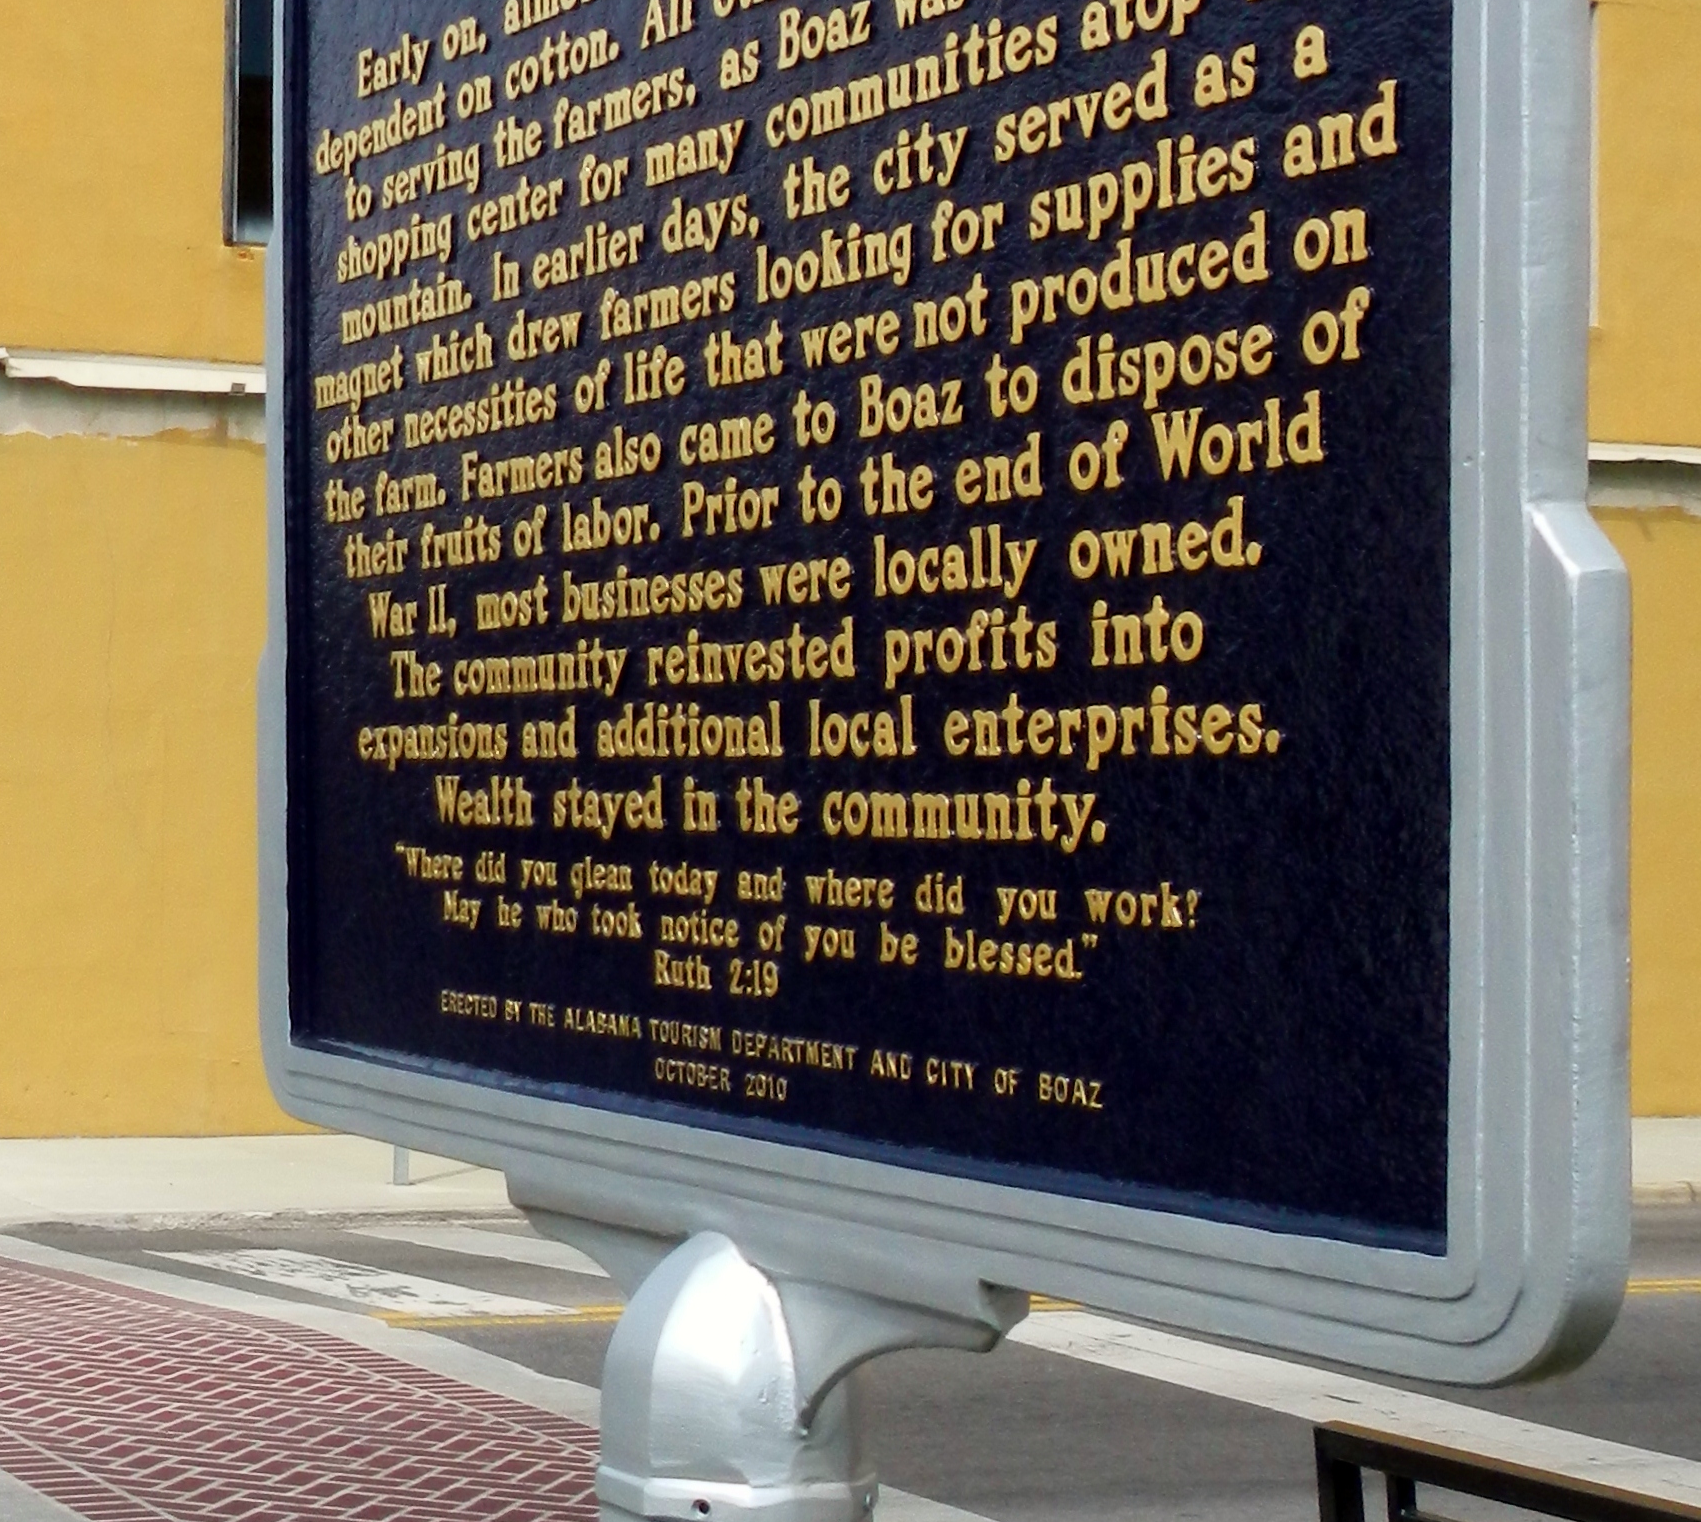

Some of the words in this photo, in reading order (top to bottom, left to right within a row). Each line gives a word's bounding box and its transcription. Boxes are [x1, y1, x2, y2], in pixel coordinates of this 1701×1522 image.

[314, 85, 447, 180] dependent
[456, 77, 493, 119] on
[504, 29, 620, 100] cotton.
[345, 181, 373, 222] to
[382, 144, 481, 209] serving
[493, 117, 543, 169] the
[553, 67, 697, 149] farmers,
[719, 39, 760, 91] as
[778, 0, 872, 70] Boaz
[358, 34, 430, 96] Early
[441, 18, 487, 61] on,
[337, 214, 453, 284] shopping
[466, 176, 564, 242] center
[578, 154, 630, 208] for
[645, 117, 745, 188] many
[765, 14, 1058, 149] communities
[341, 274, 473, 345] mountain.
[491, 251, 521, 302] In
[532, 220, 645, 291] earlier
[660, 192, 760, 255] days,
[782, 155, 851, 221] the
[872, 121, 969, 196] city
[993, 47, 1169, 164] served
[1193, 43, 1257, 109] as
[1292, 23, 1329, 80] a
[314, 347, 405, 415] magnet
[415, 321, 494, 383] which
[505, 309, 582, 362] drew
[599, 271, 736, 342] farmers
[755, 222, 914, 305] looking
[930, 198, 1005, 264] for
[1028, 133, 1256, 242] supplies
[1282, 78, 1399, 179] and
[325, 412, 395, 465] other
[403, 376, 558, 449] necessities
[573, 358, 612, 415] of
[623, 344, 687, 406] life
[702, 319, 785, 389] that
[800, 309, 902, 369] were
[912, 272, 990, 349] not
[1009, 208, 1270, 346] produced
[1292, 207, 1369, 272] on
[324, 479, 366, 524] the
[373, 470, 447, 517] farm.
[461, 446, 584, 502] Farmers
[593, 425, 662, 482] also
[678, 412, 776, 467] came
[791, 389, 837, 448] to
[857, 373, 964, 439] Boaz
[983, 352, 1039, 419] to
[1060, 323, 1274, 412] dispose
[1301, 285, 1372, 366] of
[342, 528, 409, 579] their
[419, 515, 502, 571] fruits
[512, 503, 548, 559] of
[561, 495, 661, 554] labor.
[681, 475, 780, 539] Prior
[797, 464, 843, 525] to
[858, 451, 935, 517] the
[954, 430, 1044, 506] end
[1068, 419, 1131, 492] of
[1150, 388, 1325, 482] World
[367, 591, 419, 638] War
[426, 584, 458, 638] II,
[475, 574, 550, 632] most
[561, 565, 744, 624] businesses
[758, 556, 852, 606] were
[873, 523, 1038, 600] locally
[1068, 494, 1263, 580] owned.
[388, 649, 442, 700] The
[452, 637, 628, 698] community
[646, 615, 857, 687] reinvested
[883, 604, 1058, 690] profits
[1090, 594, 1205, 668] into
[357, 712, 509, 771] expansions
[521, 705, 578, 760] and
[596, 700, 784, 759] additional
[808, 693, 917, 758] local
[943, 684, 1282, 772] enterprises.
[434, 775, 533, 828] Wealth
[552, 774, 665, 841] stayed
[682, 777, 718, 833] in
[734, 776, 800, 835] the
[821, 777, 1107, 854] community.
[443, 890, 481, 930] May
[497, 895, 522, 929] he
[535, 899, 578, 934] who
[590, 902, 643, 940] took
[660, 909, 740, 949] notice
[757, 915, 786, 953] of
[803, 925, 856, 963] you
[879, 922, 919, 966] be
[474, 851, 507, 885] did
[520, 858, 558, 889] you
[569, 857, 634, 901] glean
[647, 862, 719, 906] today
[737, 869, 784, 903] and
[804, 868, 894, 910] where
[914, 871, 965, 916] did
[995, 886, 1058, 927] you
[1084, 881, 1199, 929] work?
[653, 949, 711, 992] Ruth
[728, 957, 780, 998] 2:19
[439, 988, 498, 1019] ERECTED
[504, 999, 522, 1022] BY
[528, 1001, 556, 1027] THE
[563, 1007, 643, 1039] ALABAMA
[648, 1018, 723, 1052] TOURISM
[731, 1029, 858, 1071] DEPARTMENT
[870, 1051, 910, 1081] AND
[925, 1059, 974, 1089] CITY
[993, 1068, 1017, 1095] OF
[1038, 1073, 1102, 1109] BOAZ
[654, 1057, 731, 1093] OCTOBER
[745, 1072, 789, 1102] 2010
